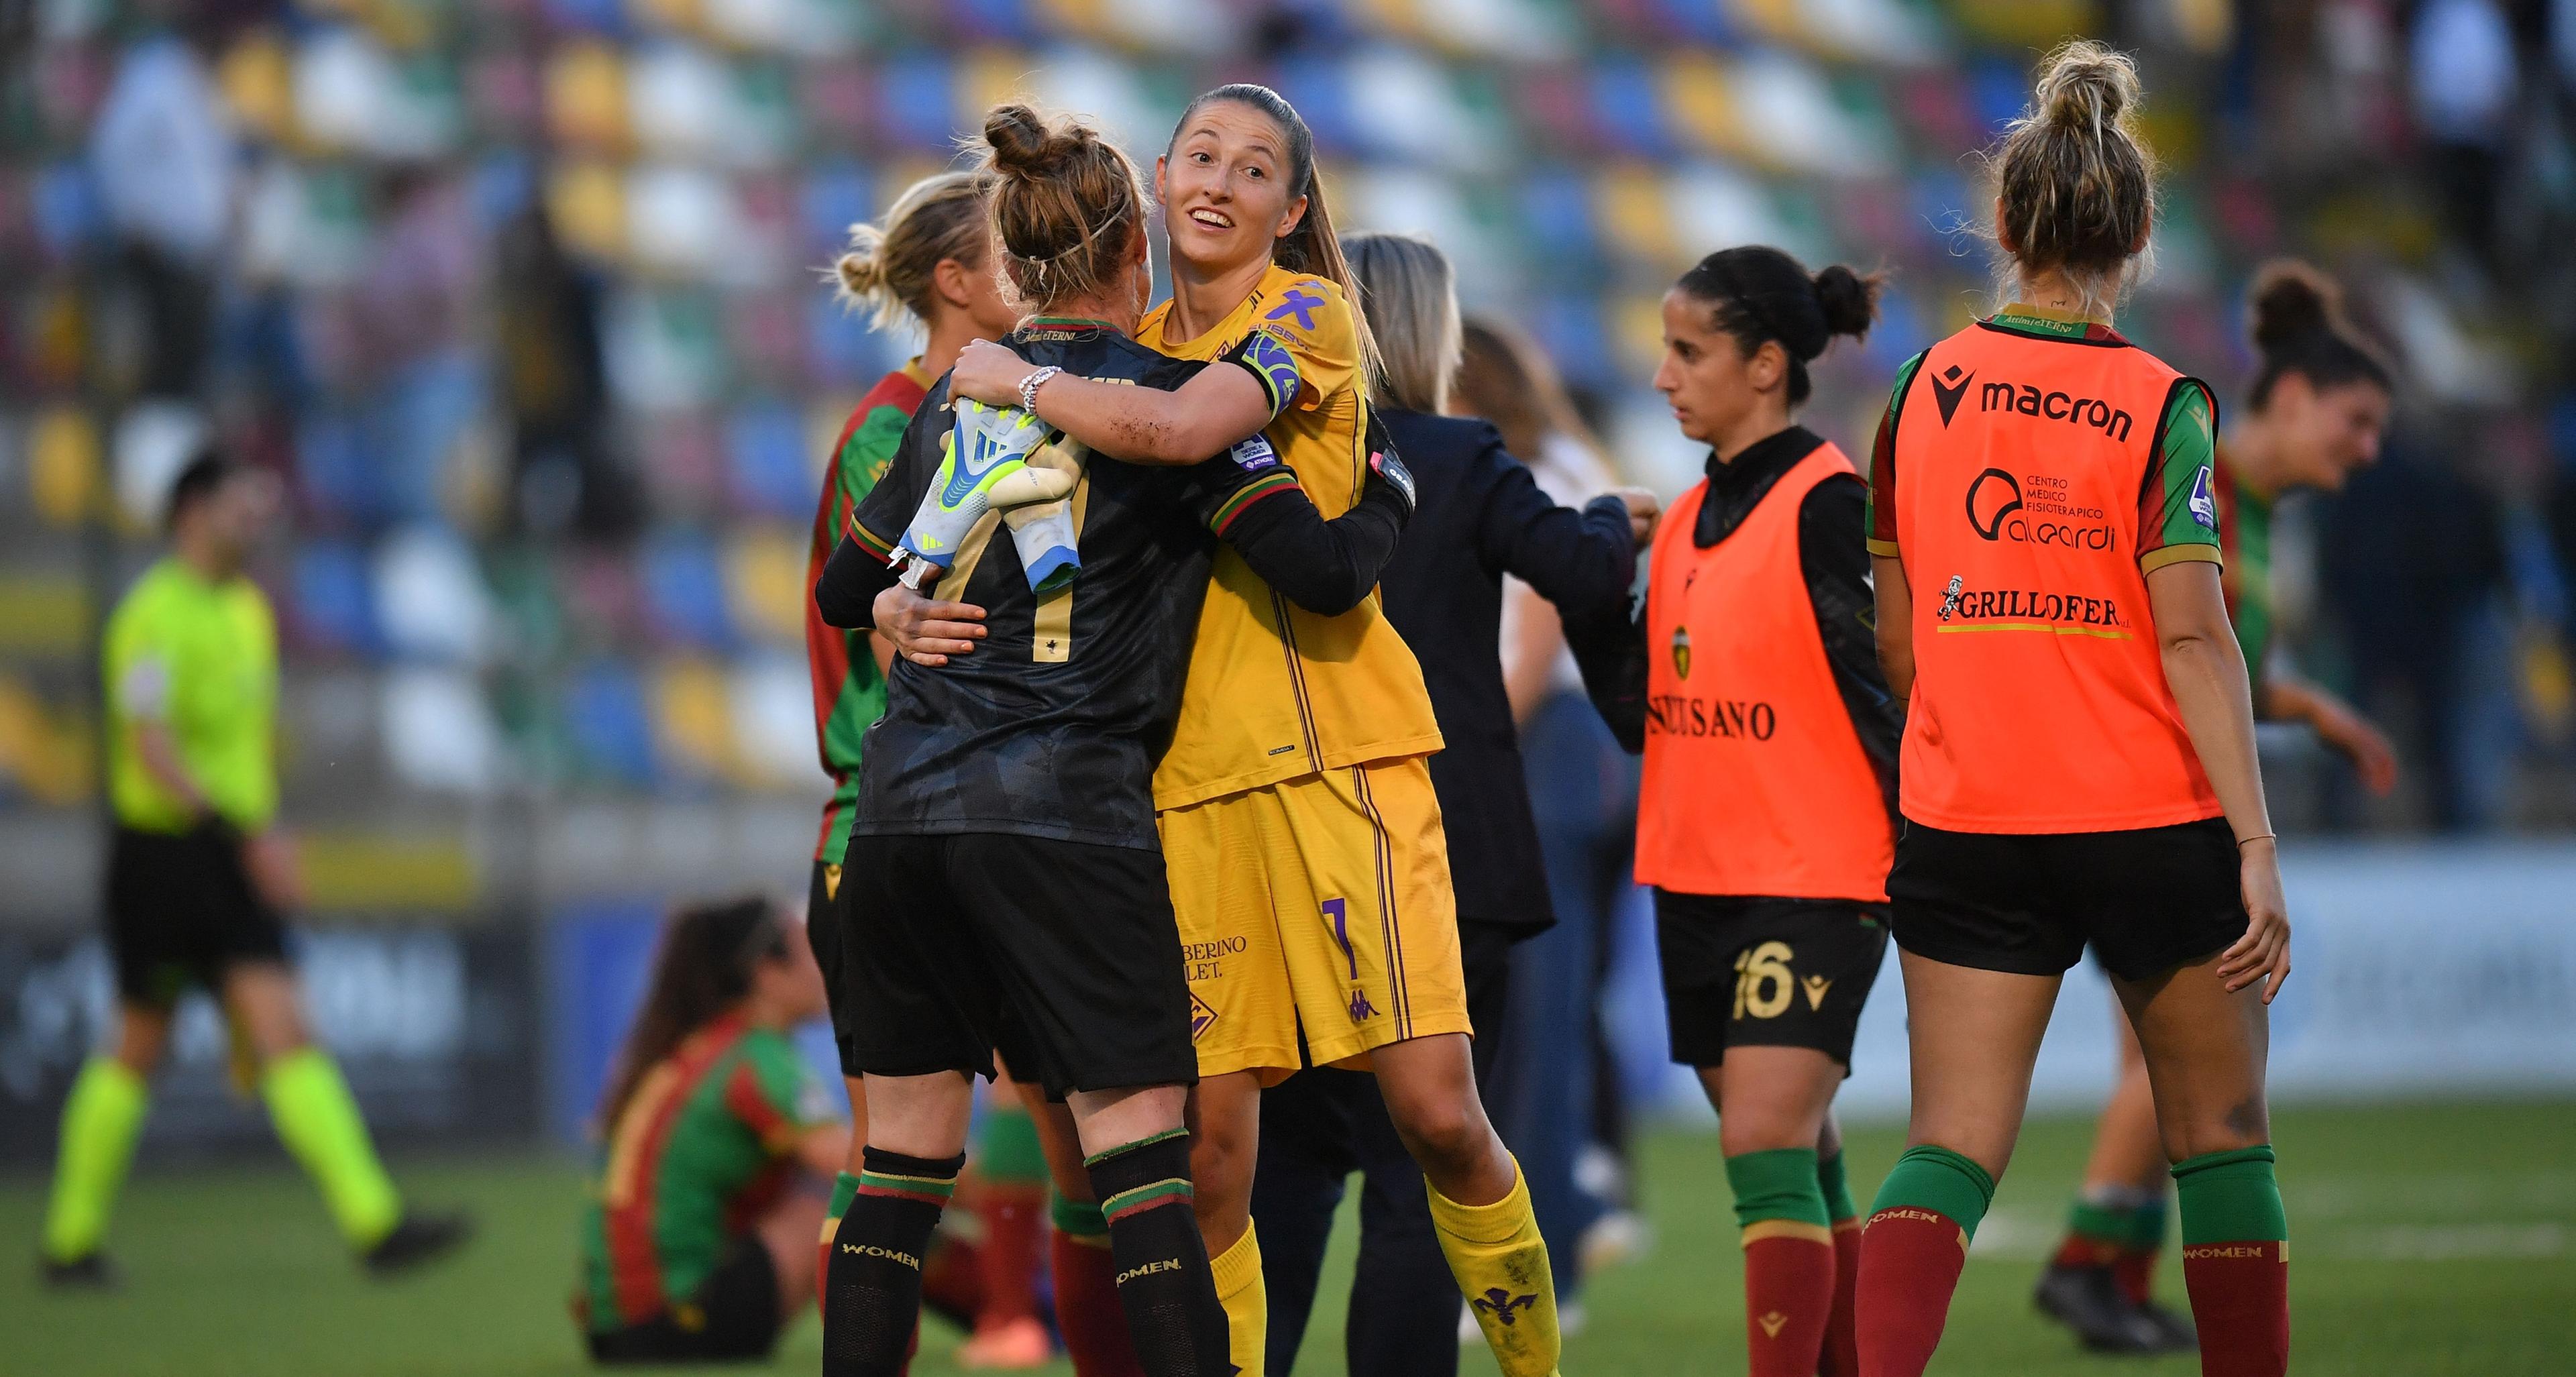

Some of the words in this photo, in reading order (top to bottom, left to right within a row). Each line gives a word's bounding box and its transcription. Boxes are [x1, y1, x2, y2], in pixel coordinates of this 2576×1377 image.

[1982, 382, 2133, 443] macron
[2027, 475, 2068, 489] CENTRO
[2027, 489, 2066, 502] MEDICO
[2027, 502, 2104, 519] FISIOTERAPICO
[2008, 516, 2115, 553] aleardi
[1958, 590, 2120, 626] GRILLOFER
[1733, 940, 1794, 1020] 16
[843, 1244, 919, 1271] WOMEN
[2183, 1247, 2262, 1260] WOMEN
[1116, 1258, 1182, 1288] OMEN
